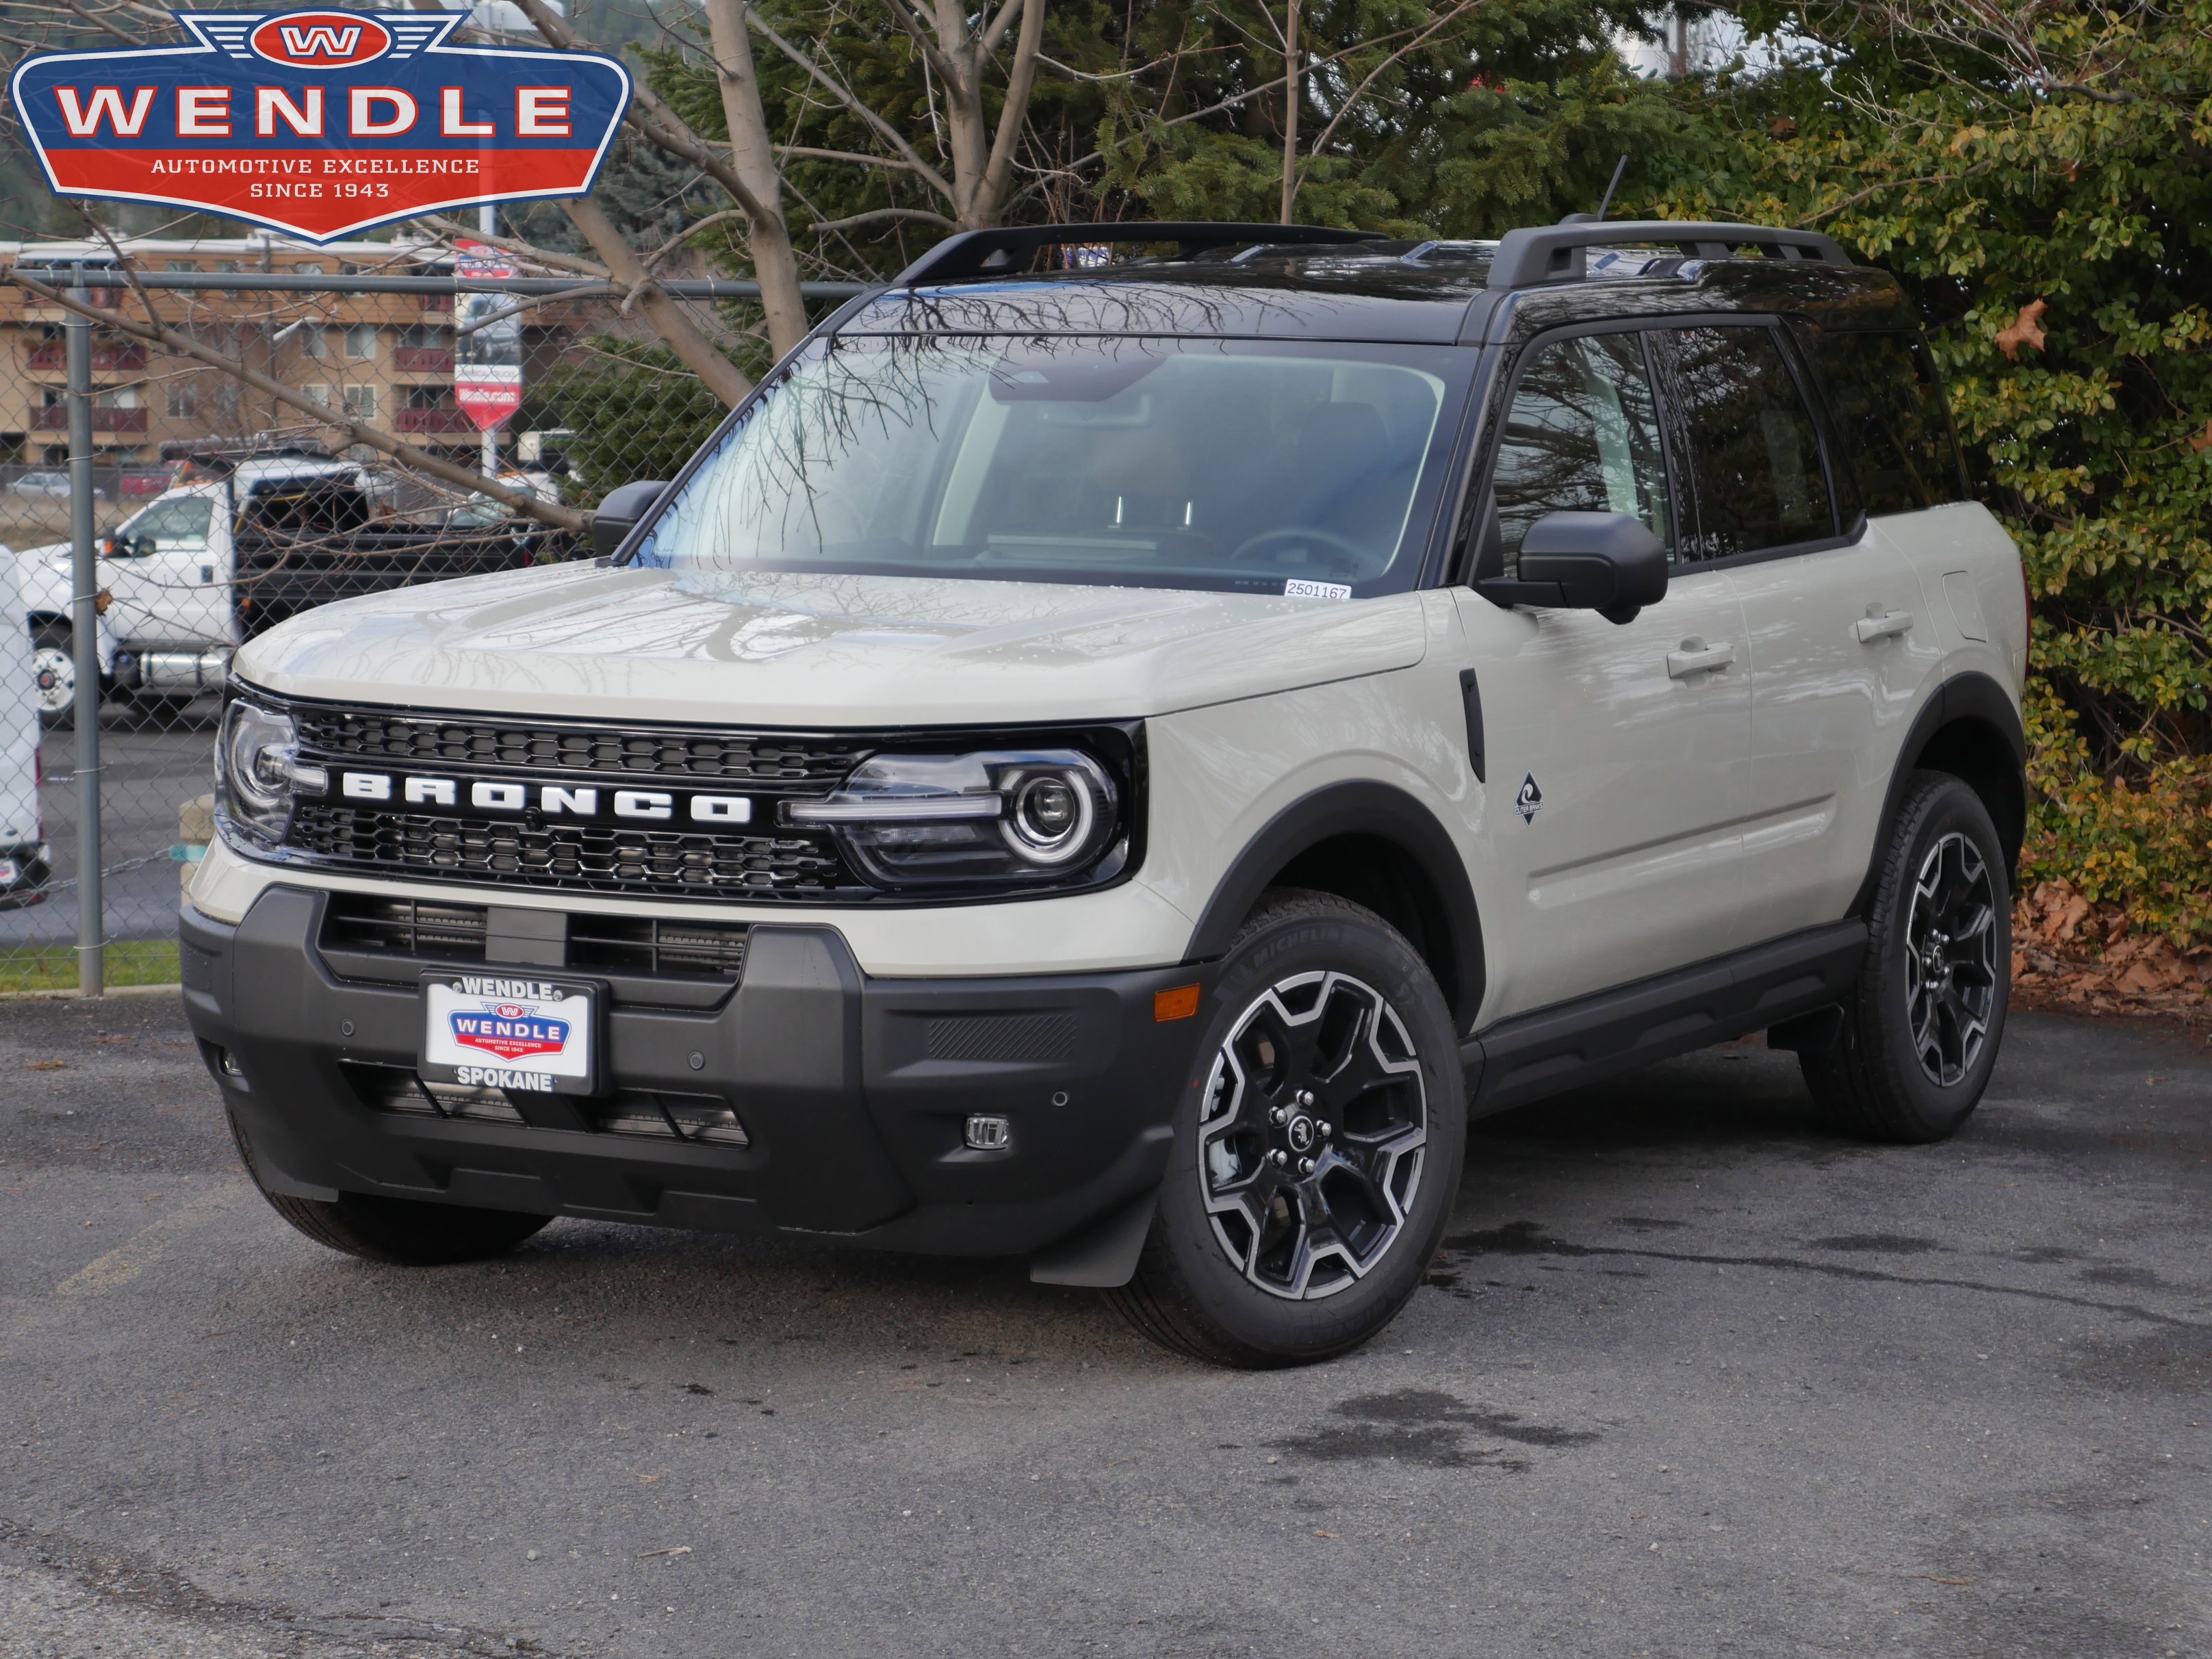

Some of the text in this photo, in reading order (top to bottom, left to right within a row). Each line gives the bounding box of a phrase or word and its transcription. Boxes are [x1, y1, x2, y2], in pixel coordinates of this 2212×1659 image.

[1287, 582, 1348, 599] 2501167
[343, 772, 751, 822] BRONCO
[462, 977, 553, 1001] WENDLE
[456, 1018, 560, 1040] WENDLE
[457, 1066, 552, 1092] SPOKANE
